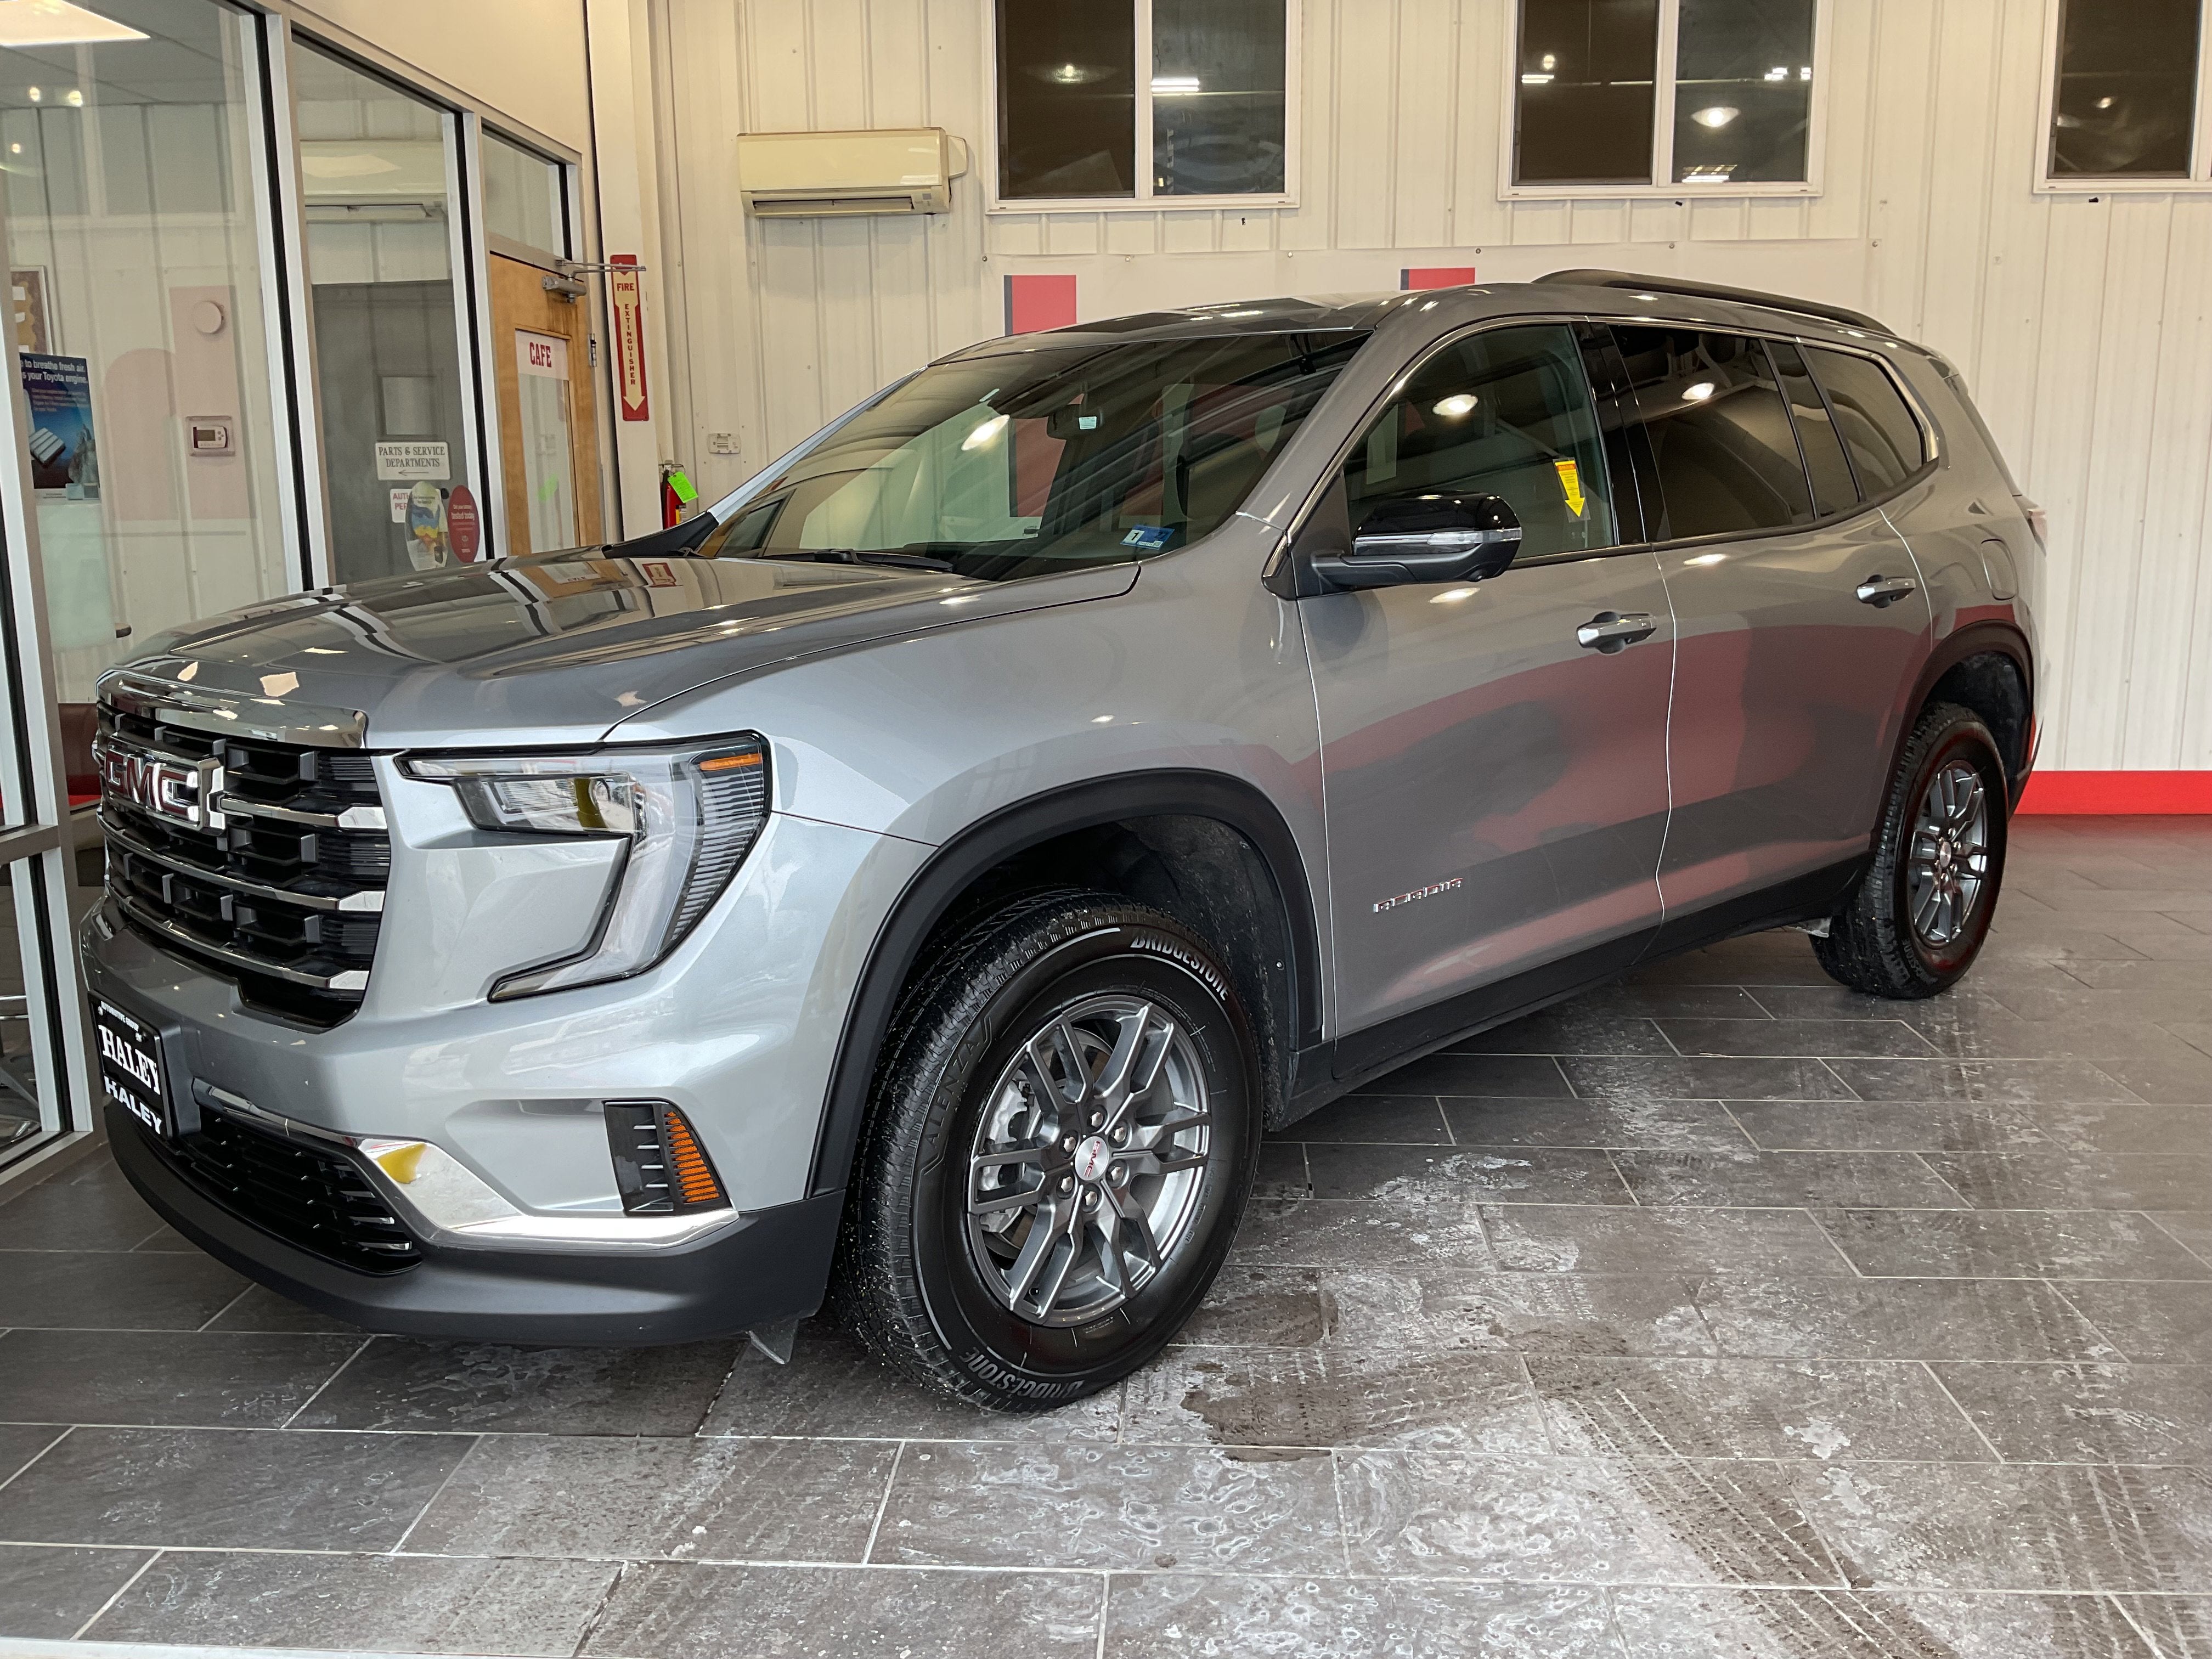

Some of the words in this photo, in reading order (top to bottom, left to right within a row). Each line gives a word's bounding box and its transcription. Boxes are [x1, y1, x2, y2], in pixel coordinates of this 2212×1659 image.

[617, 283, 635, 291] FIRE
[529, 342, 552, 368] CAFE
[624, 304, 635, 385] EXTINGUISHER
[25, 359, 32, 368] to
[33, 360, 58, 370] breathe
[59, 362, 75, 371] fresh
[28, 372, 42, 381] your
[43, 371, 64, 383] Toyota
[379, 447, 402, 456] PARTS
[405, 447, 410, 455] &
[413, 446, 445, 456] SERVICE
[386, 458, 440, 467] DEPARTMENTS
[1131, 532, 1139, 541] 1
[105, 747, 199, 823] GMC
[1373, 878, 1463, 912] ACADIA
[1130, 933, 1229, 1001] BRIDGESTONE
[98, 1024, 160, 1095] HALEY
[104, 1075, 162, 1135] HALEY
[924, 1040, 980, 1149] ALENZA
[1084, 1141, 1101, 1177] GMC
[958, 1346, 1085, 1399] BRIDGESTONE
